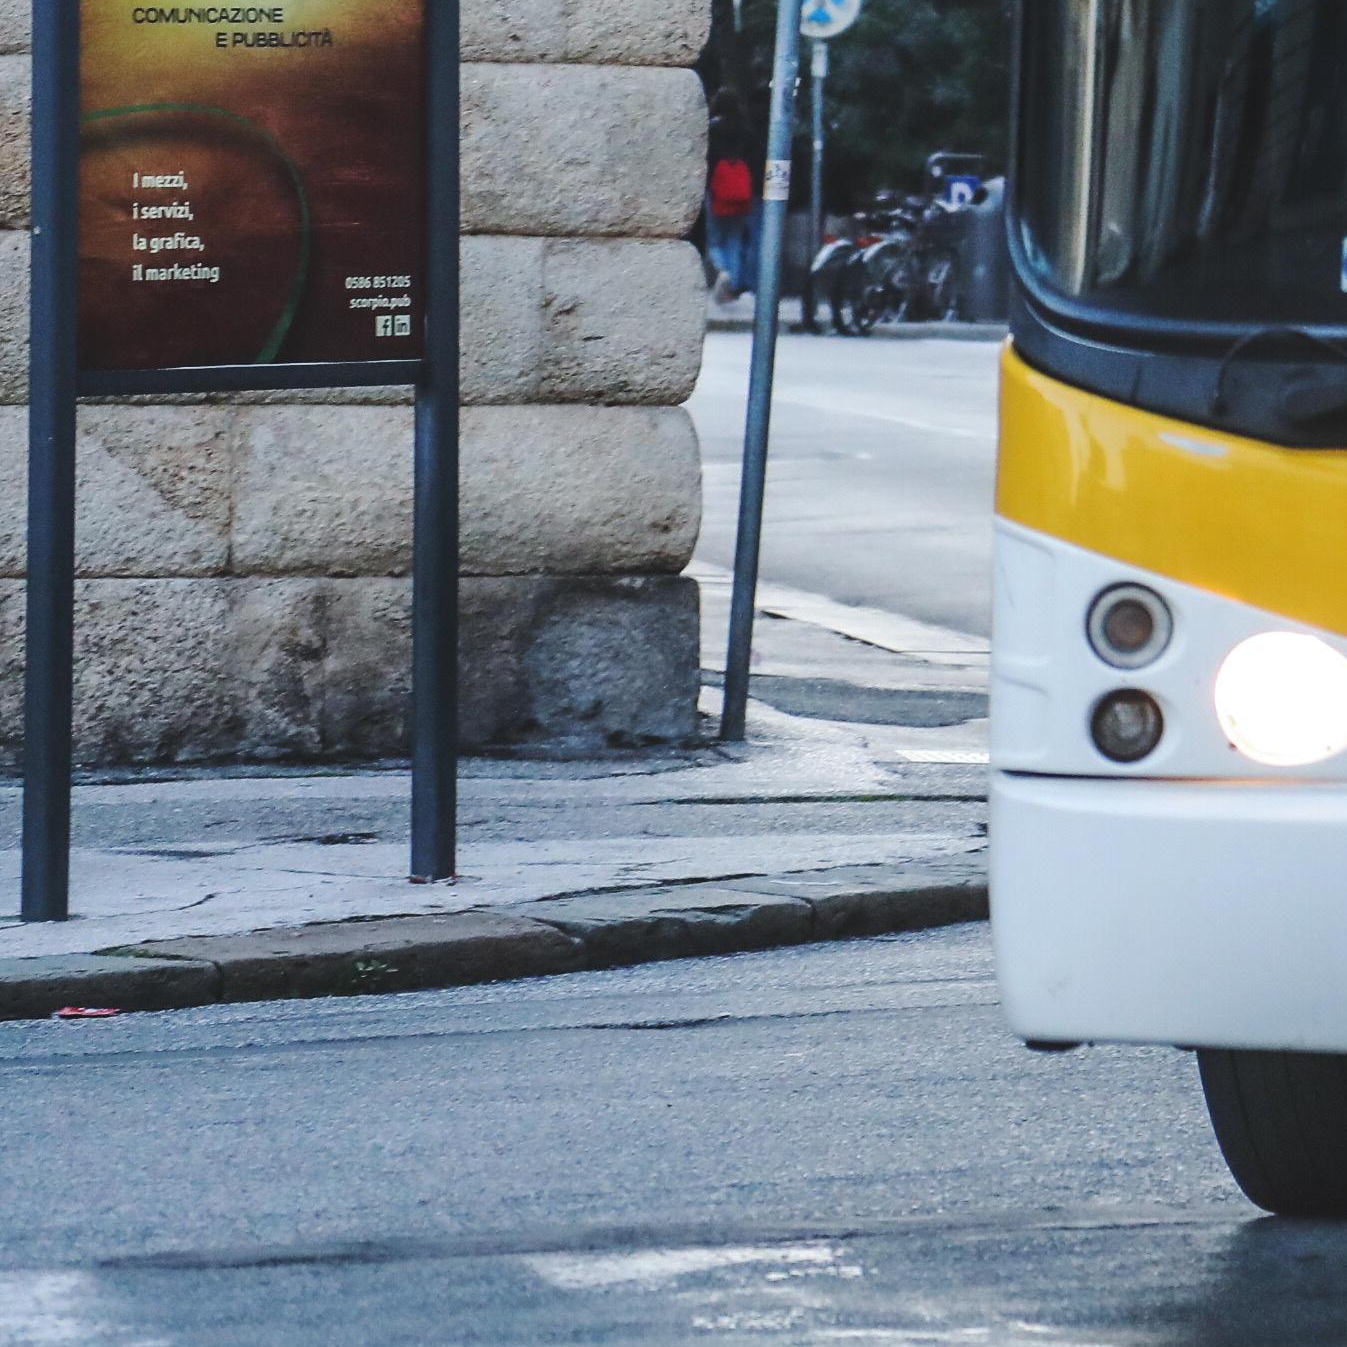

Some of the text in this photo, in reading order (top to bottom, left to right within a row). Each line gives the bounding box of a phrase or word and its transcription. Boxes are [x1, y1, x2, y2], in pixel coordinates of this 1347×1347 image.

[132, 7, 284, 24] COMUNICAZIONE
[216, 27, 333, 48] E PUBBLICITÀ
[141, 170, 188, 190] mezzi,
[133, 202, 194, 220] i servizi,
[133, 232, 205, 253] la grafica,
[132, 263, 220, 283] il marketing
[349, 294, 411, 310] scorpio.pub
